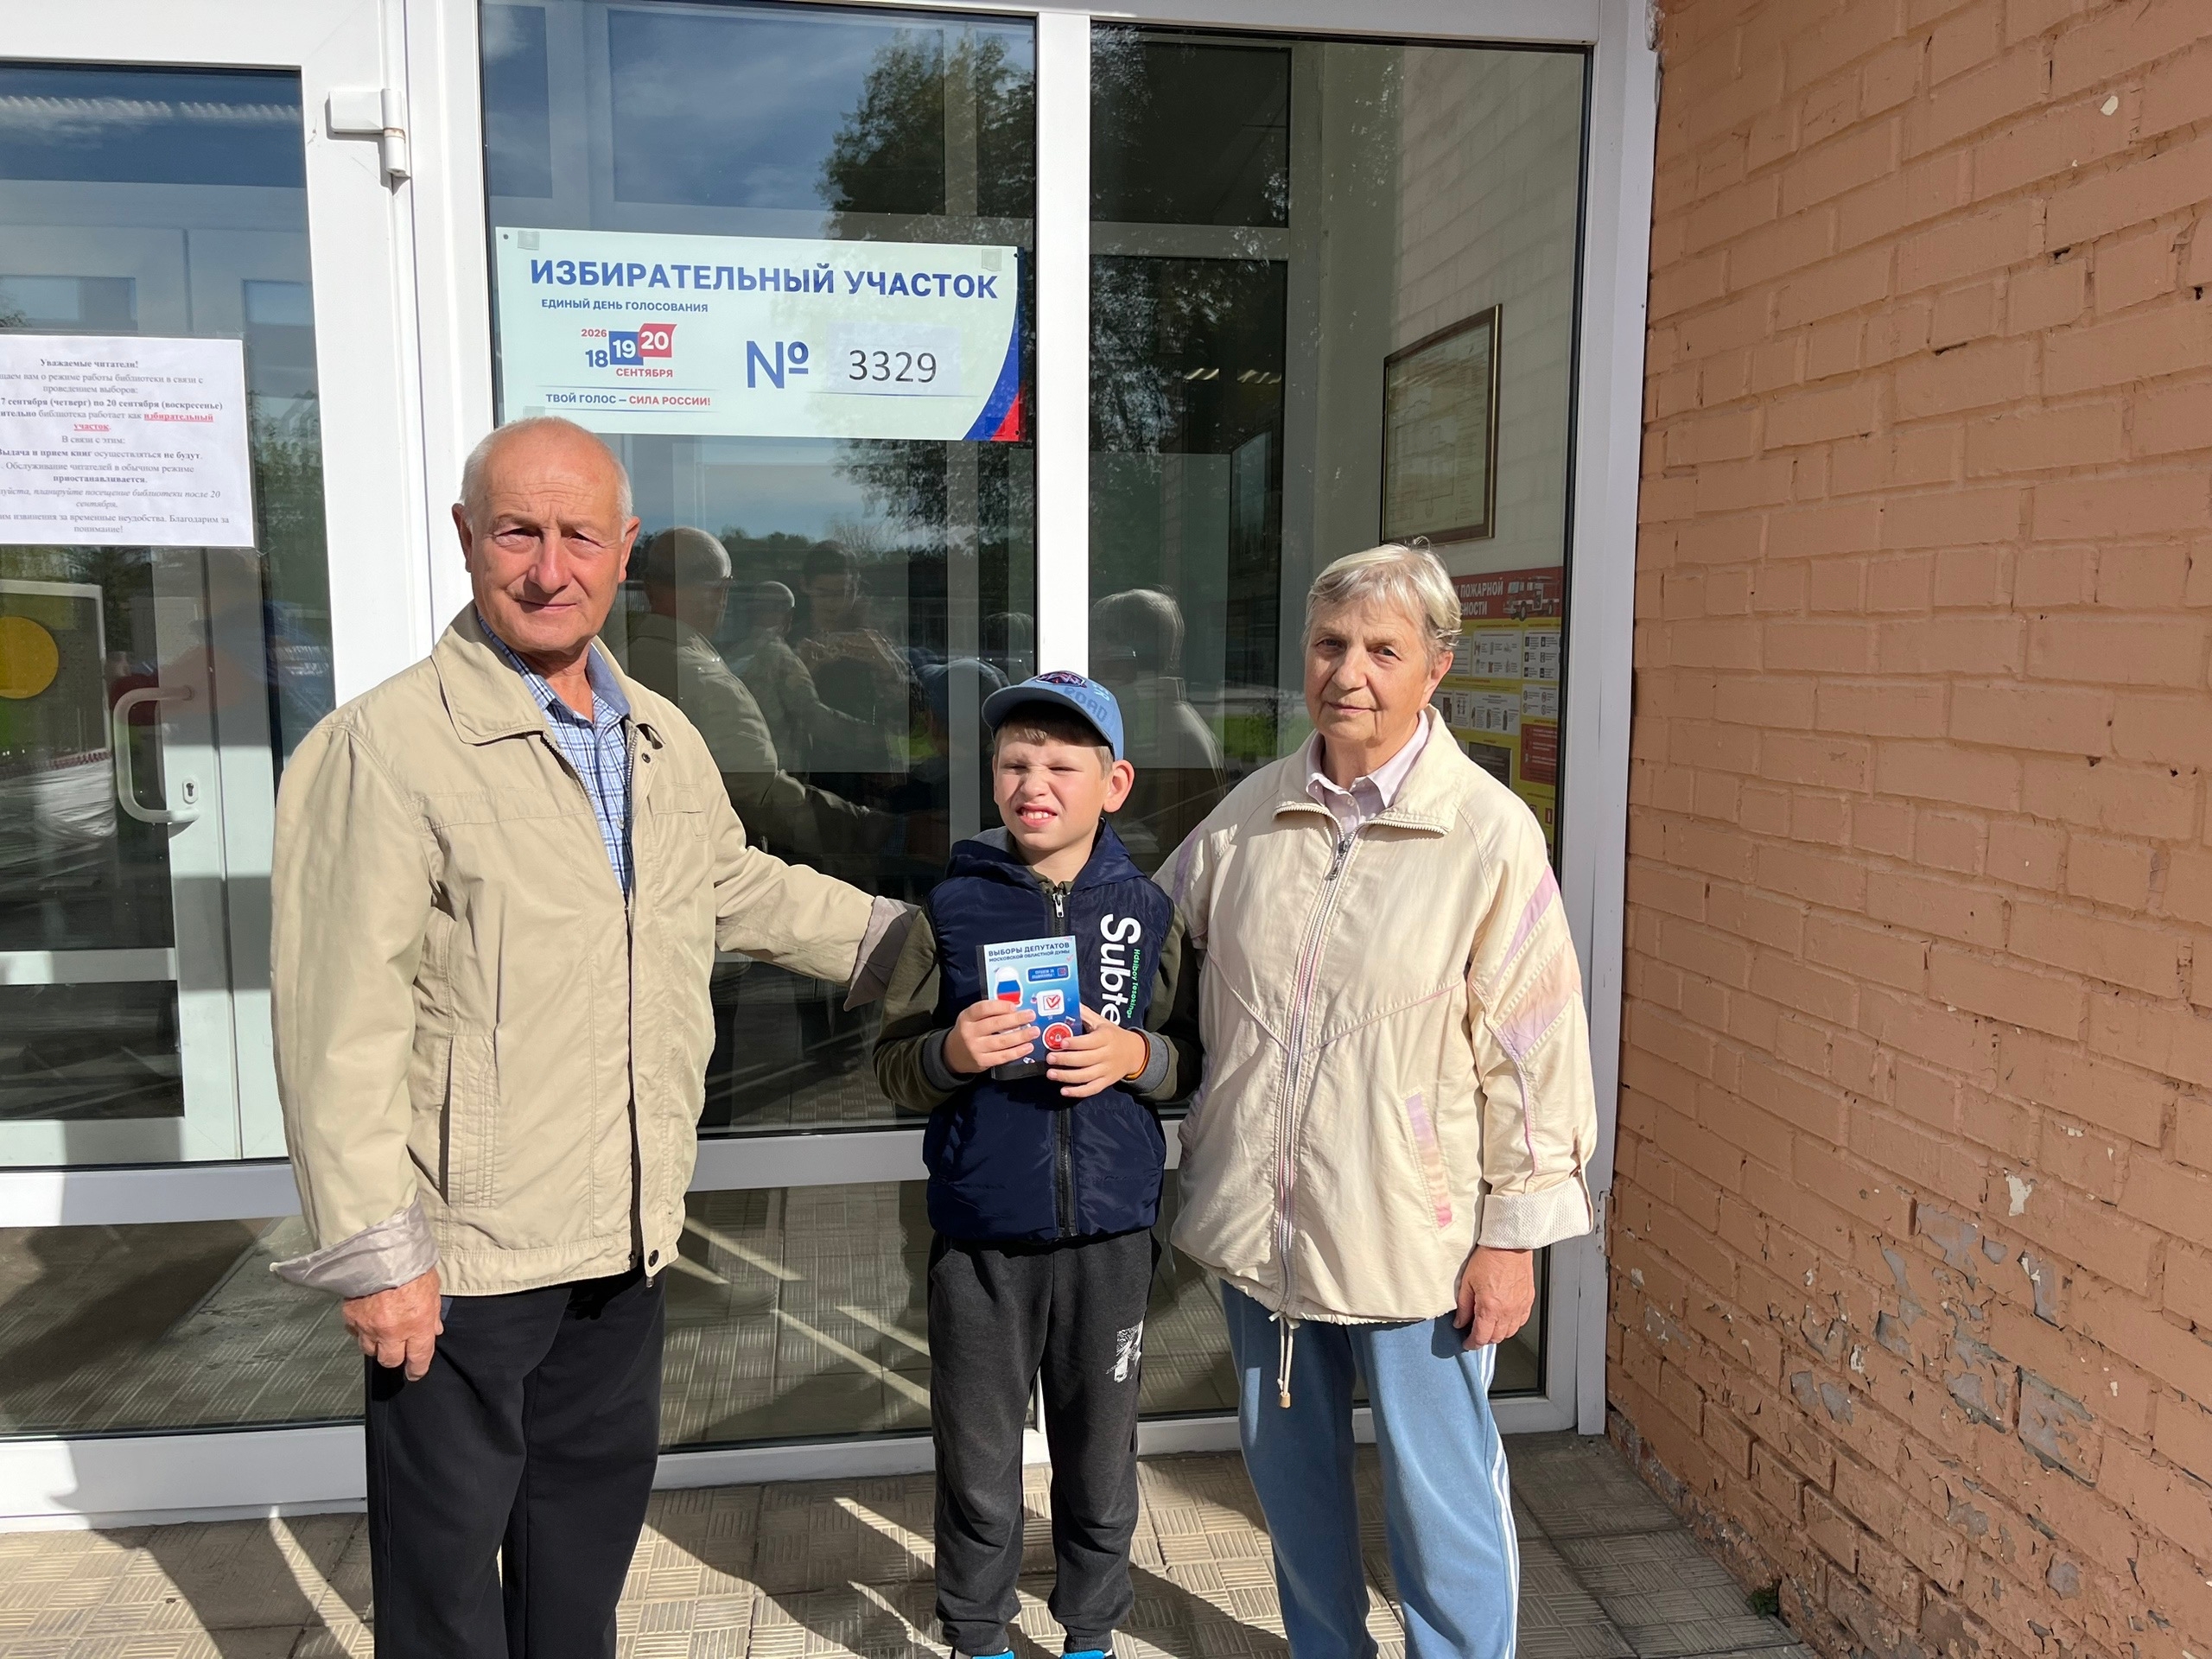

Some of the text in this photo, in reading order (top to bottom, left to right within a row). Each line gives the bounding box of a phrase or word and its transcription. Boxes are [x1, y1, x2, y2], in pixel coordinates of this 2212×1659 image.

[530, 259, 999, 299] ИЗБИРАТЕЛЬНЫЙ УЧАСТОК
[542, 298, 709, 312] ЕДИНЫЙ ДЕНЬ ГОЛОСОВАНИЯ
[581, 328, 607, 338] 2026
[585, 331, 670, 367] 18 19 20
[40, 359, 138, 369] Уважаемые читатели!
[849, 349, 938, 384] 3329
[83, 374, 113, 383] работы
[115, 374, 165, 383] библиотеки
[616, 368, 673, 378] СЕНТЯБРЯ
[43, 385, 138, 395] проведением выборов:
[8, 398, 48, 409] сентября
[50, 397, 92, 409] (четверг)
[118, 399, 160, 410] сентября
[162, 400, 223, 410] (воскресенье)
[545, 392, 576, 404] ТВОЙ
[579, 395, 617, 404] ГОЛОС
[629, 396, 659, 405] СИЛА
[662, 397, 711, 406] РОССИИ!
[39, 410, 87, 418] библиотека
[88, 410, 125, 420] работает
[143, 411, 214, 423] избирательный
[61, 435, 68, 443] В
[41, 449, 68, 458] прием
[94, 451, 162, 460] осуществляться
[176, 451, 203, 461] будут.
[5, 461, 68, 472] Обслуживание
[122, 463, 160, 472] обычном
[162, 466, 194, 474] режиме
[53, 475, 148, 484] приостанавливается.
[34, 487, 84, 498] планируйте
[85, 489, 130, 498] посещение
[132, 488, 183, 498] библиотеки
[210, 490, 221, 499] 20
[75, 500, 118, 510] сентября.
[70, 515, 117, 524] временные
[118, 514, 167, 524] неудобства.
[169, 515, 219, 524] Благодарим
[73, 524, 124, 533] понимание!
[1460, 577, 1503, 598] ПОЖАРНОЙ
[988, 943, 1070, 957] ВЫБОРЫ ДЕПУТАТОВ
[988, 953, 1023, 963] МОСКОВСКОЙ
[1024, 950, 1054, 958] ОБЛАСТНОЙ
